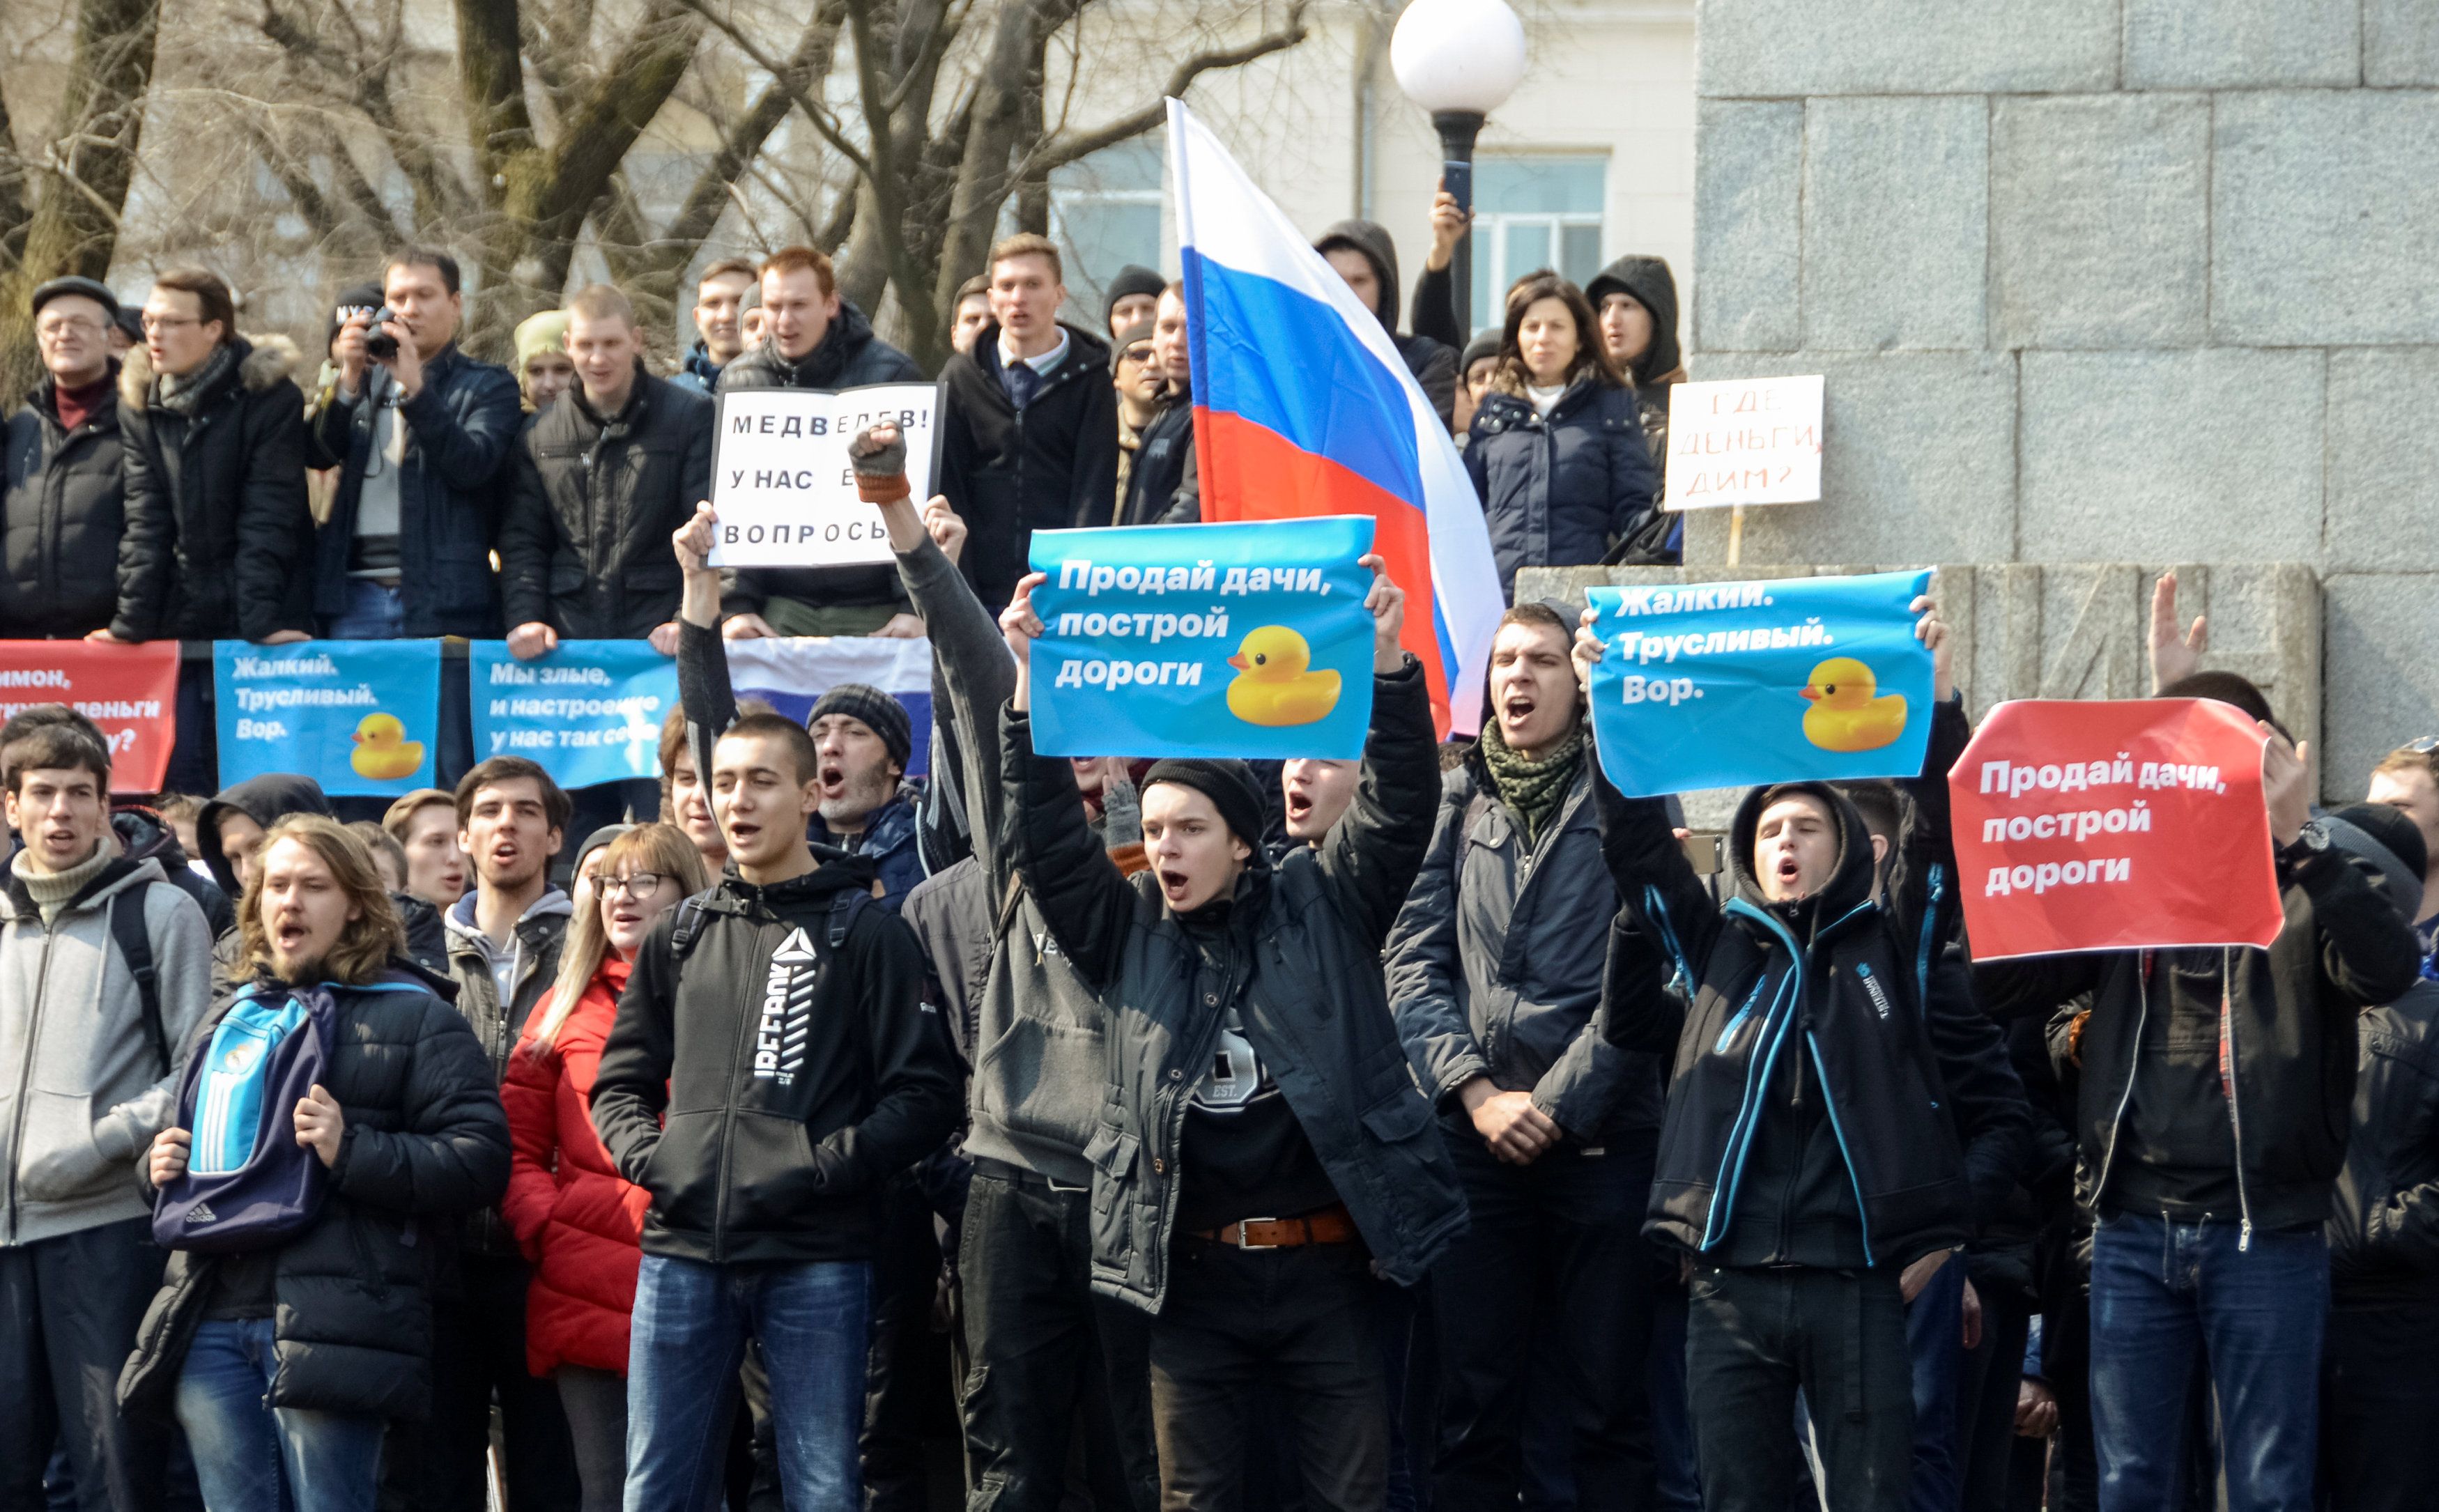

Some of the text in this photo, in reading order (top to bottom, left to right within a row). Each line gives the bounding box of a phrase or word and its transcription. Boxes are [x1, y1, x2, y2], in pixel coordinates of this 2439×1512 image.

[1712, 389, 1782, 415] ГДЕ
[1678, 424, 1822, 456] ДЕНЬГИ,
[731, 470, 813, 489] У НАС
[1686, 465, 1792, 497] ДИМ?
[1059, 560, 1332, 596] Продай дачи,
[1615, 584, 1774, 617] Жалкий.
[1058, 606, 1229, 643] построй
[1619, 617, 1833, 665] Трусливый.
[232, 654, 338, 679] Жалкий.
[490, 663, 612, 687] Мы злые,
[1055, 659, 1203, 691] дороги
[235, 683, 379, 713] Трусливый.
[1622, 675, 1705, 706] Вор.
[490, 695, 659, 720] и настроее
[236, 718, 287, 741] Вор.
[491, 731, 505, 753] у
[509, 730, 555, 748] нас
[558, 730, 601, 748] так
[1980, 752, 2226, 799] Продай дачи,
[1983, 799, 2151, 842] построй
[1985, 857, 2131, 897] дороги
[1213, 1085, 1237, 1098] EST.
